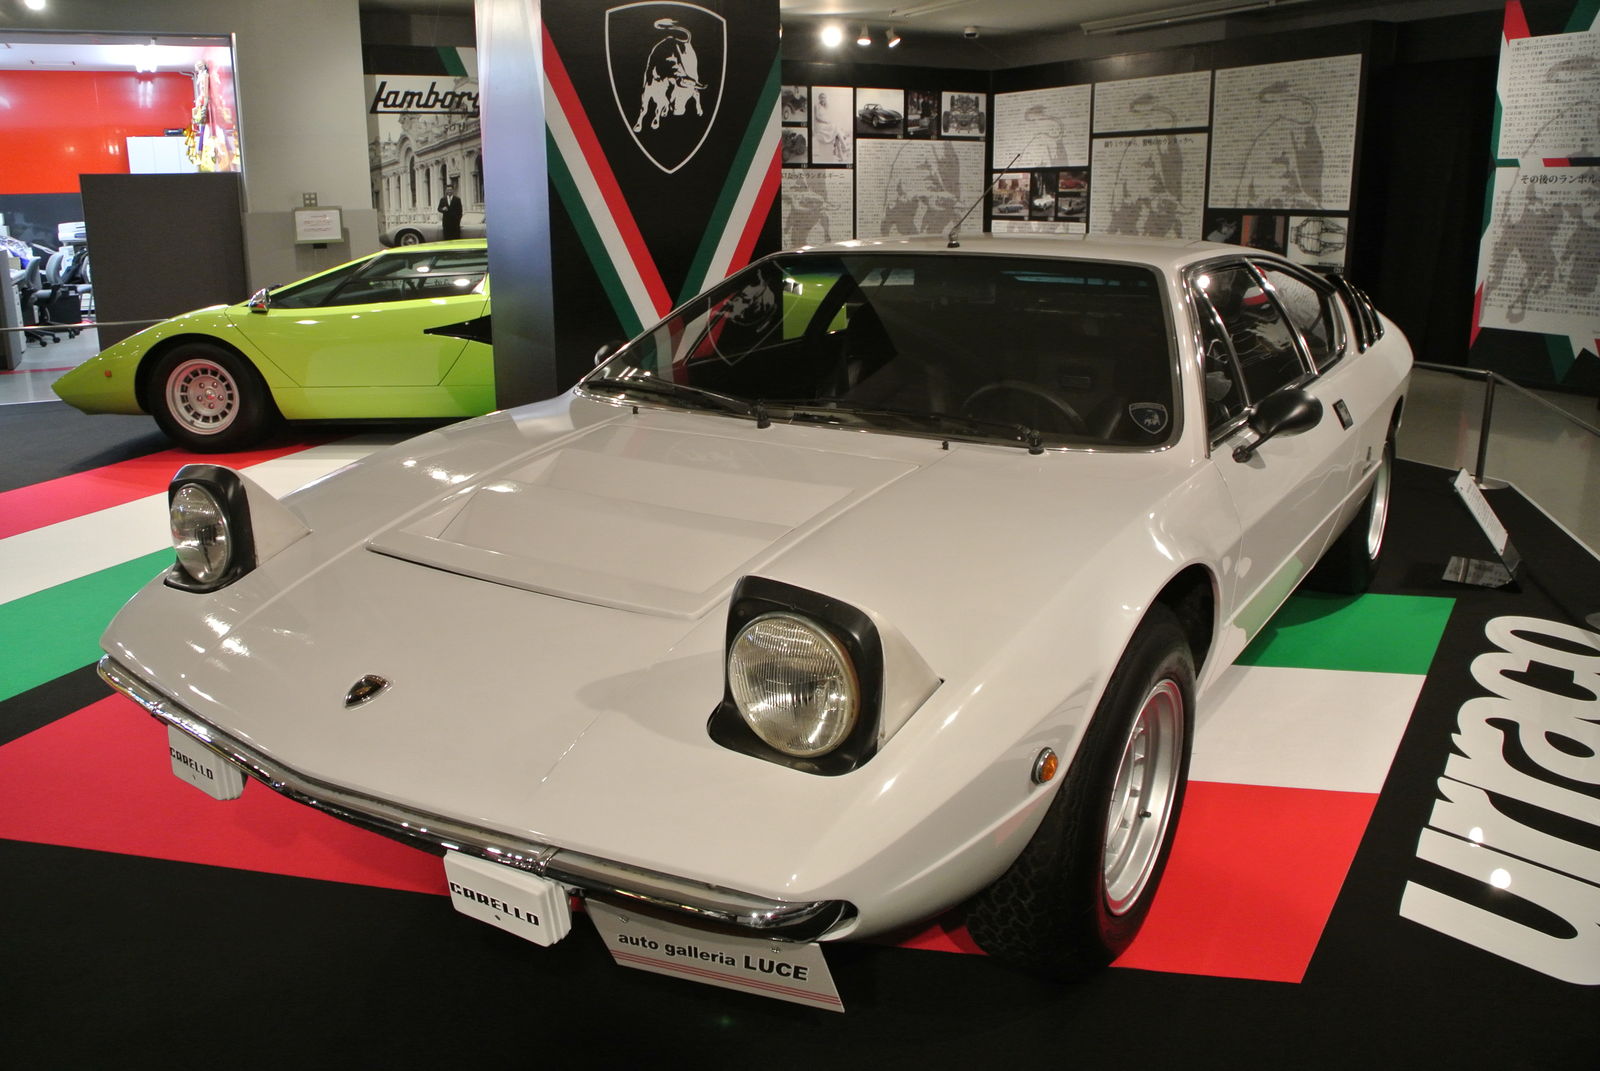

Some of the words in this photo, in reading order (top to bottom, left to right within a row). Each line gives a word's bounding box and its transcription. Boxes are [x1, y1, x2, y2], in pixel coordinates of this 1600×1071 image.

[1520, 174, 1600, 185] その後のランボル
[169, 746, 214, 780] CARELLO
[450, 882, 540, 926] CARELLO
[618, 934, 659, 950] auto
[664, 944, 736, 967] galleria
[744, 955, 808, 981] LUCE
